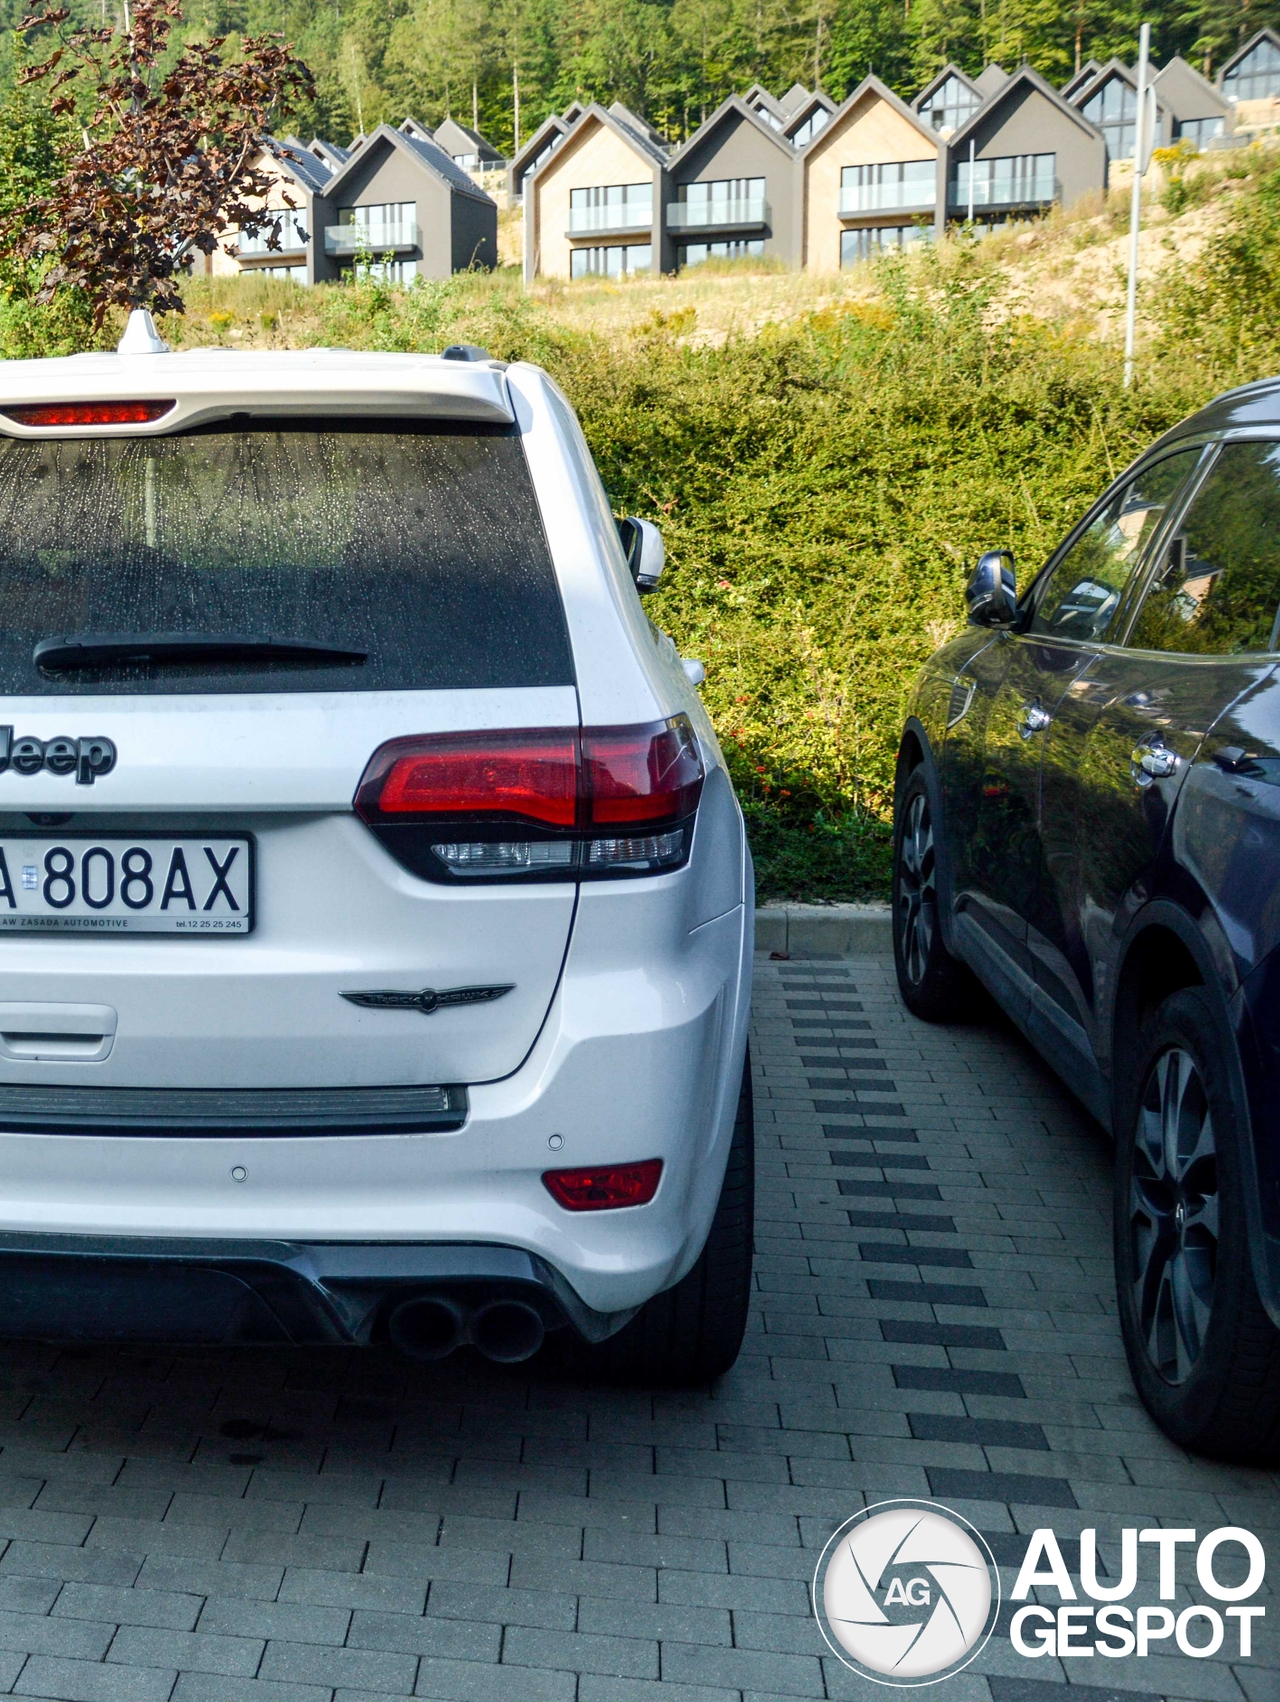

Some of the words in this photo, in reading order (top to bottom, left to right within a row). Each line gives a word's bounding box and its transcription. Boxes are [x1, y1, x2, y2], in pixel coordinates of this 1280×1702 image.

[42, 846, 240, 911] 808AX
[20, 918, 60, 927] ZASADA
[64, 919, 128, 928] AUTOMOTIVE
